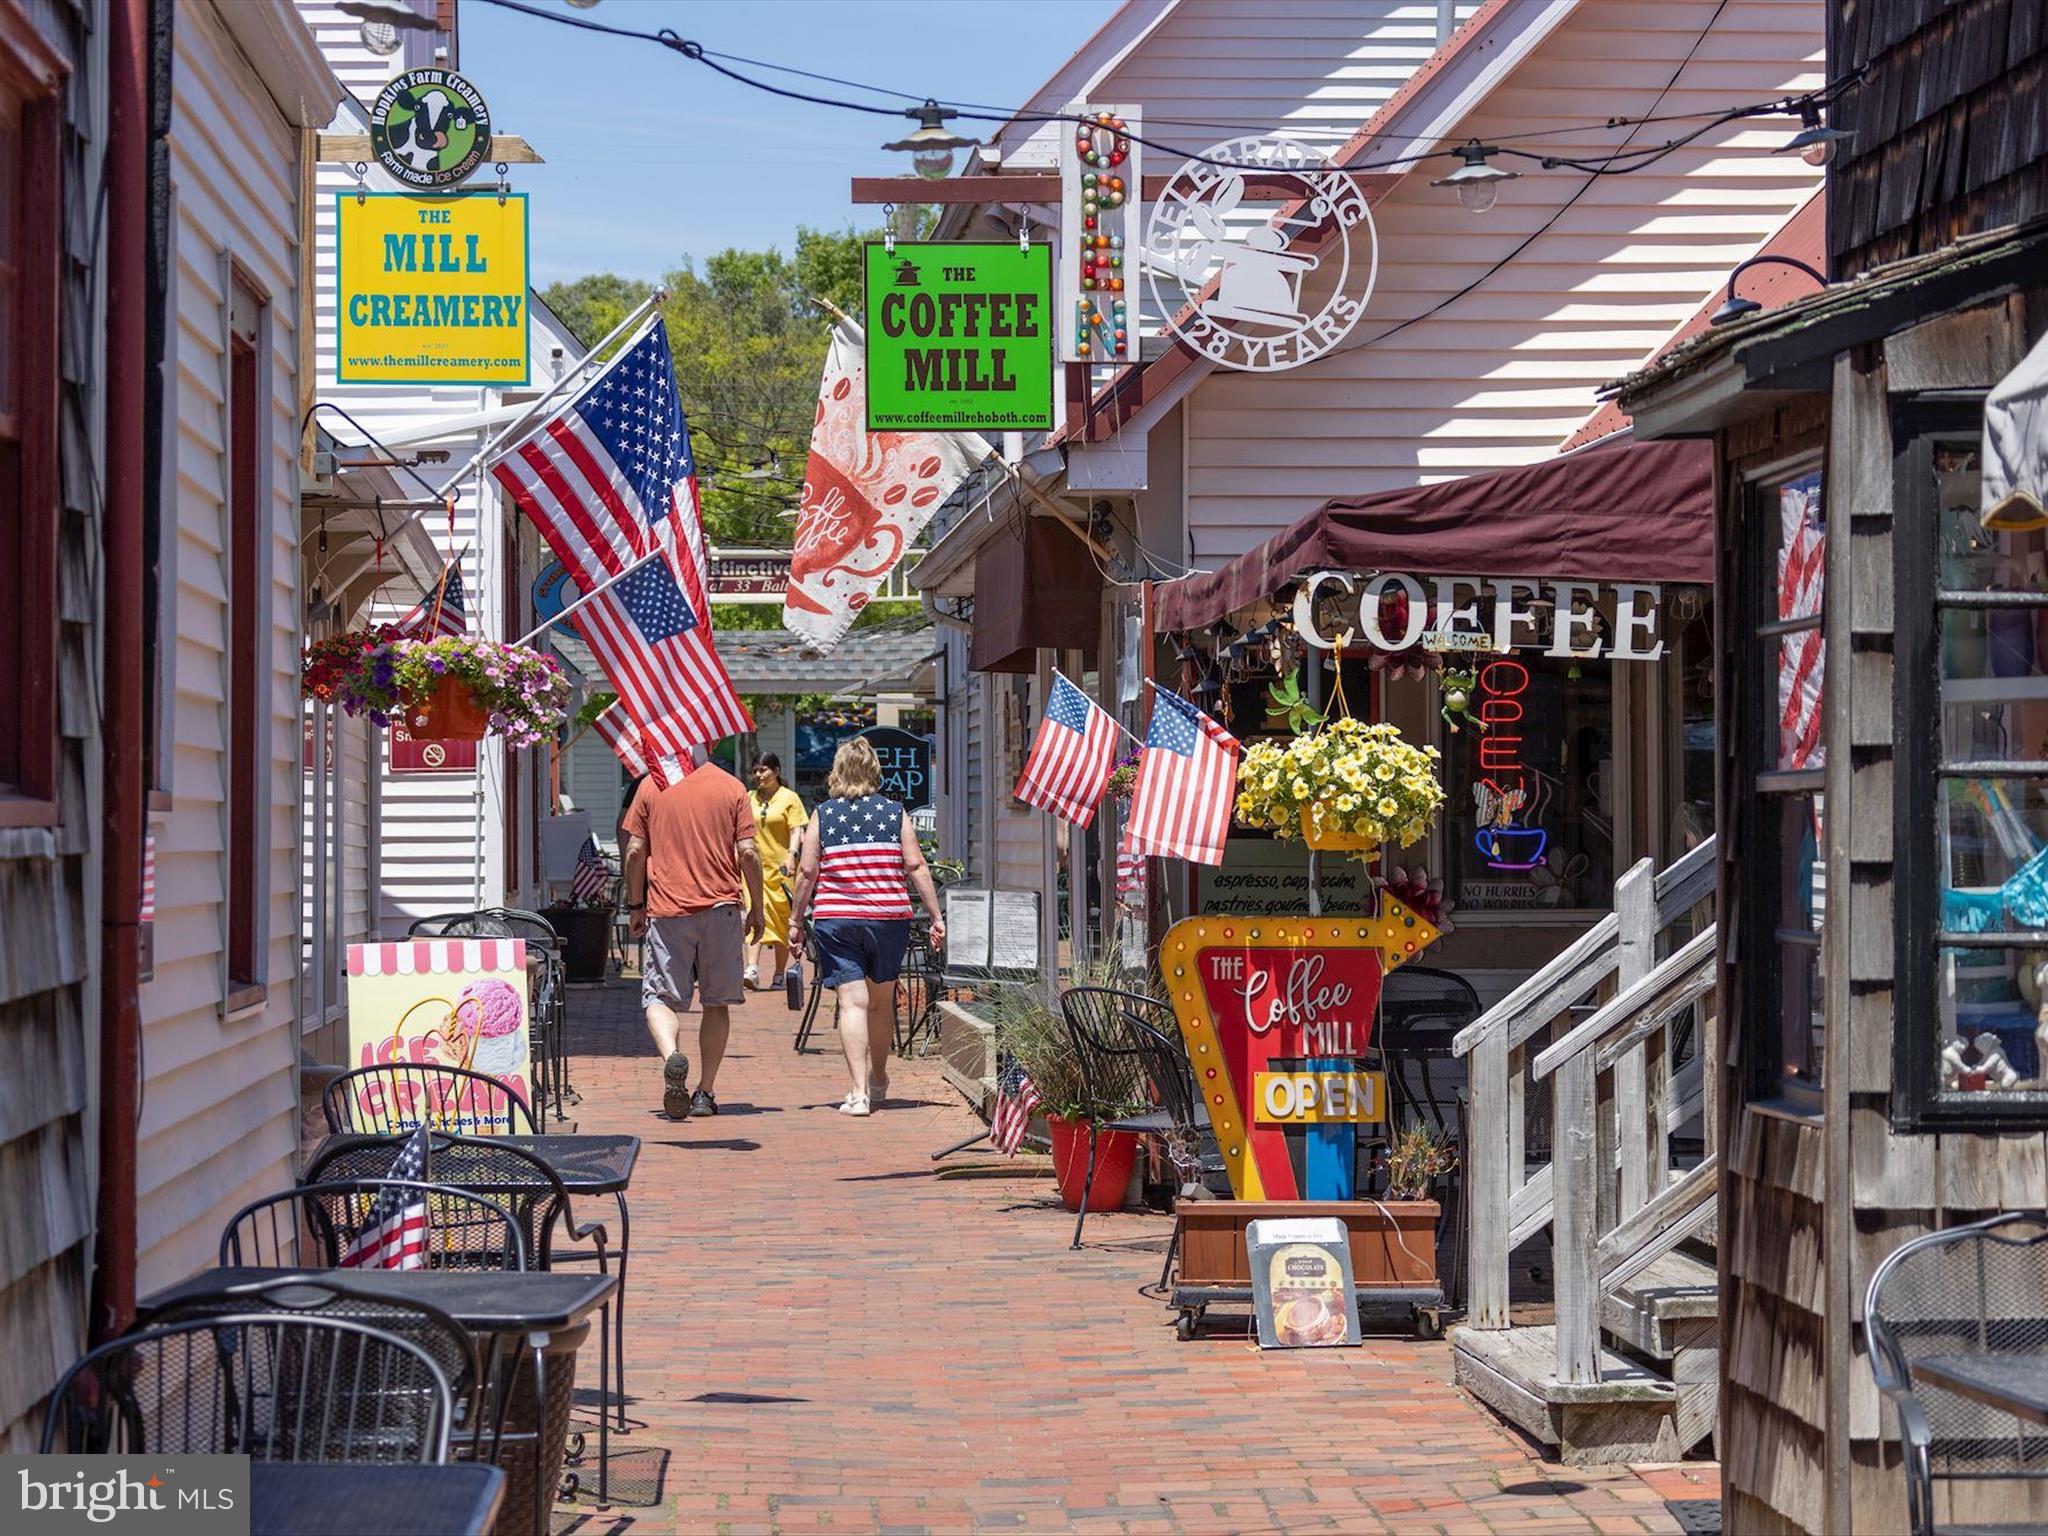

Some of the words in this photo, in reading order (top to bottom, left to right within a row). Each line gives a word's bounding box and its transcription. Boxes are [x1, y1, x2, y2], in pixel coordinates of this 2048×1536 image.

[372, 78, 408, 126] Hopkins
[408, 71, 443, 86] Farm
[446, 73, 489, 126] Creamery
[402, 170, 434, 184] made
[452, 150, 481, 177] cream
[1152, 139, 1367, 253] CELEBRATING
[418, 210, 452, 224] THE
[383, 233, 488, 273] MILL
[942, 267, 976, 282] THE
[349, 294, 523, 328] CREAMERY
[881, 292, 1039, 338] COFFEE
[1186, 318, 1232, 359] 28
[1243, 295, 1360, 367] YEARS
[348, 354, 522, 369] www.themillcreamery.com
[904, 348, 1017, 392] MILL
[874, 411, 1048, 424] www.coffeemillrehoboth.com
[734, 580, 752, 592] 33
[1292, 570, 1666, 662] COFFEE
[1424, 633, 1489, 648] WELCOME
[1463, 885, 1482, 897] NO
[1485, 885, 1537, 897] HURRIES
[1211, 956, 1245, 981] THE
[1232, 954, 1353, 1033] Coffee
[361, 1036, 440, 1067] ICE
[1302, 1021, 1357, 1056] MILL
[360, 1074, 529, 1116] CREAM
[1265, 1076, 1374, 1119] OPEN
[483, 1115, 512, 1125] More
